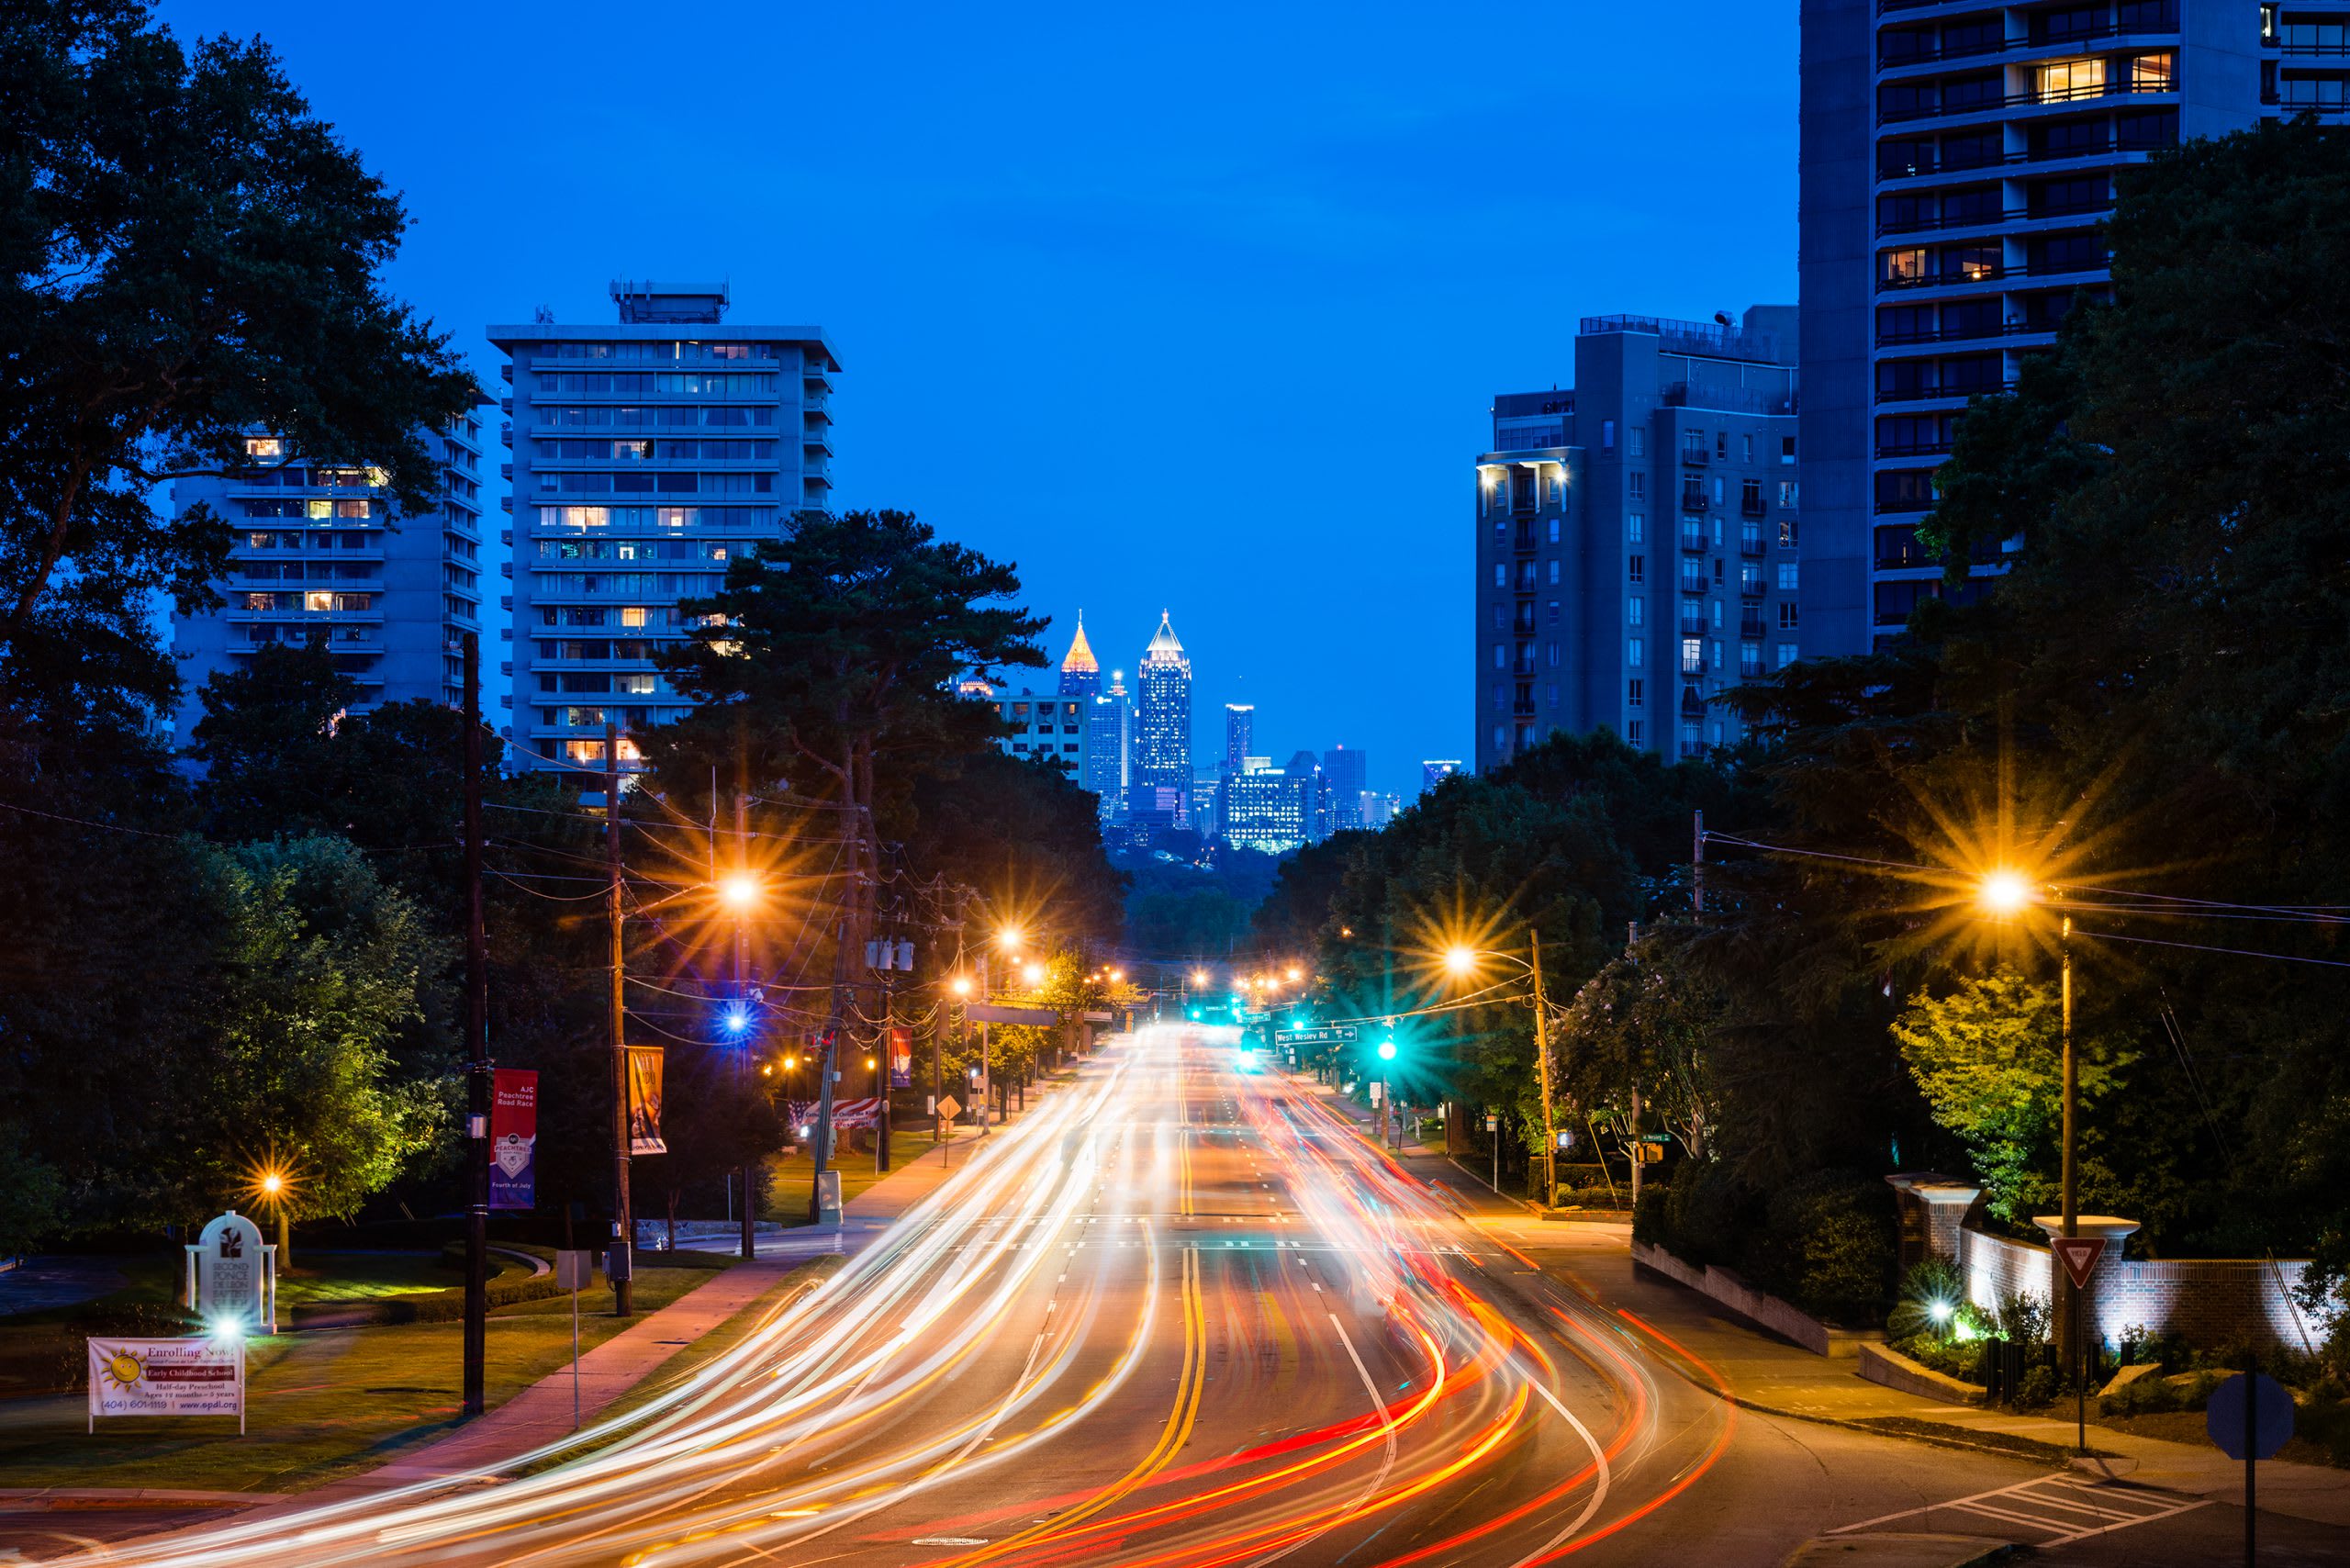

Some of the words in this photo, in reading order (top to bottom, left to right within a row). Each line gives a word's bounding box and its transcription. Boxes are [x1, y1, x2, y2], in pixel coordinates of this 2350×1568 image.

[1295, 1033, 1317, 1041] Wesley
[1319, 1031, 1328, 1039] Rd
[498, 1092, 534, 1101] Peachtree
[213, 1271, 249, 1280] PONCE
[227, 1281, 249, 1289] LEON
[148, 1347, 202, 1360] Enrolling
[205, 1347, 235, 1357] Now!
[148, 1370, 167, 1379] Early
[169, 1369, 207, 1377] Childhood
[207, 1369, 234, 1377] School
[156, 1383, 186, 1393] Half-day
[145, 1392, 162, 1401] Ages
[216, 1392, 236, 1400] years
[101, 1400, 128, 1411] (404)
